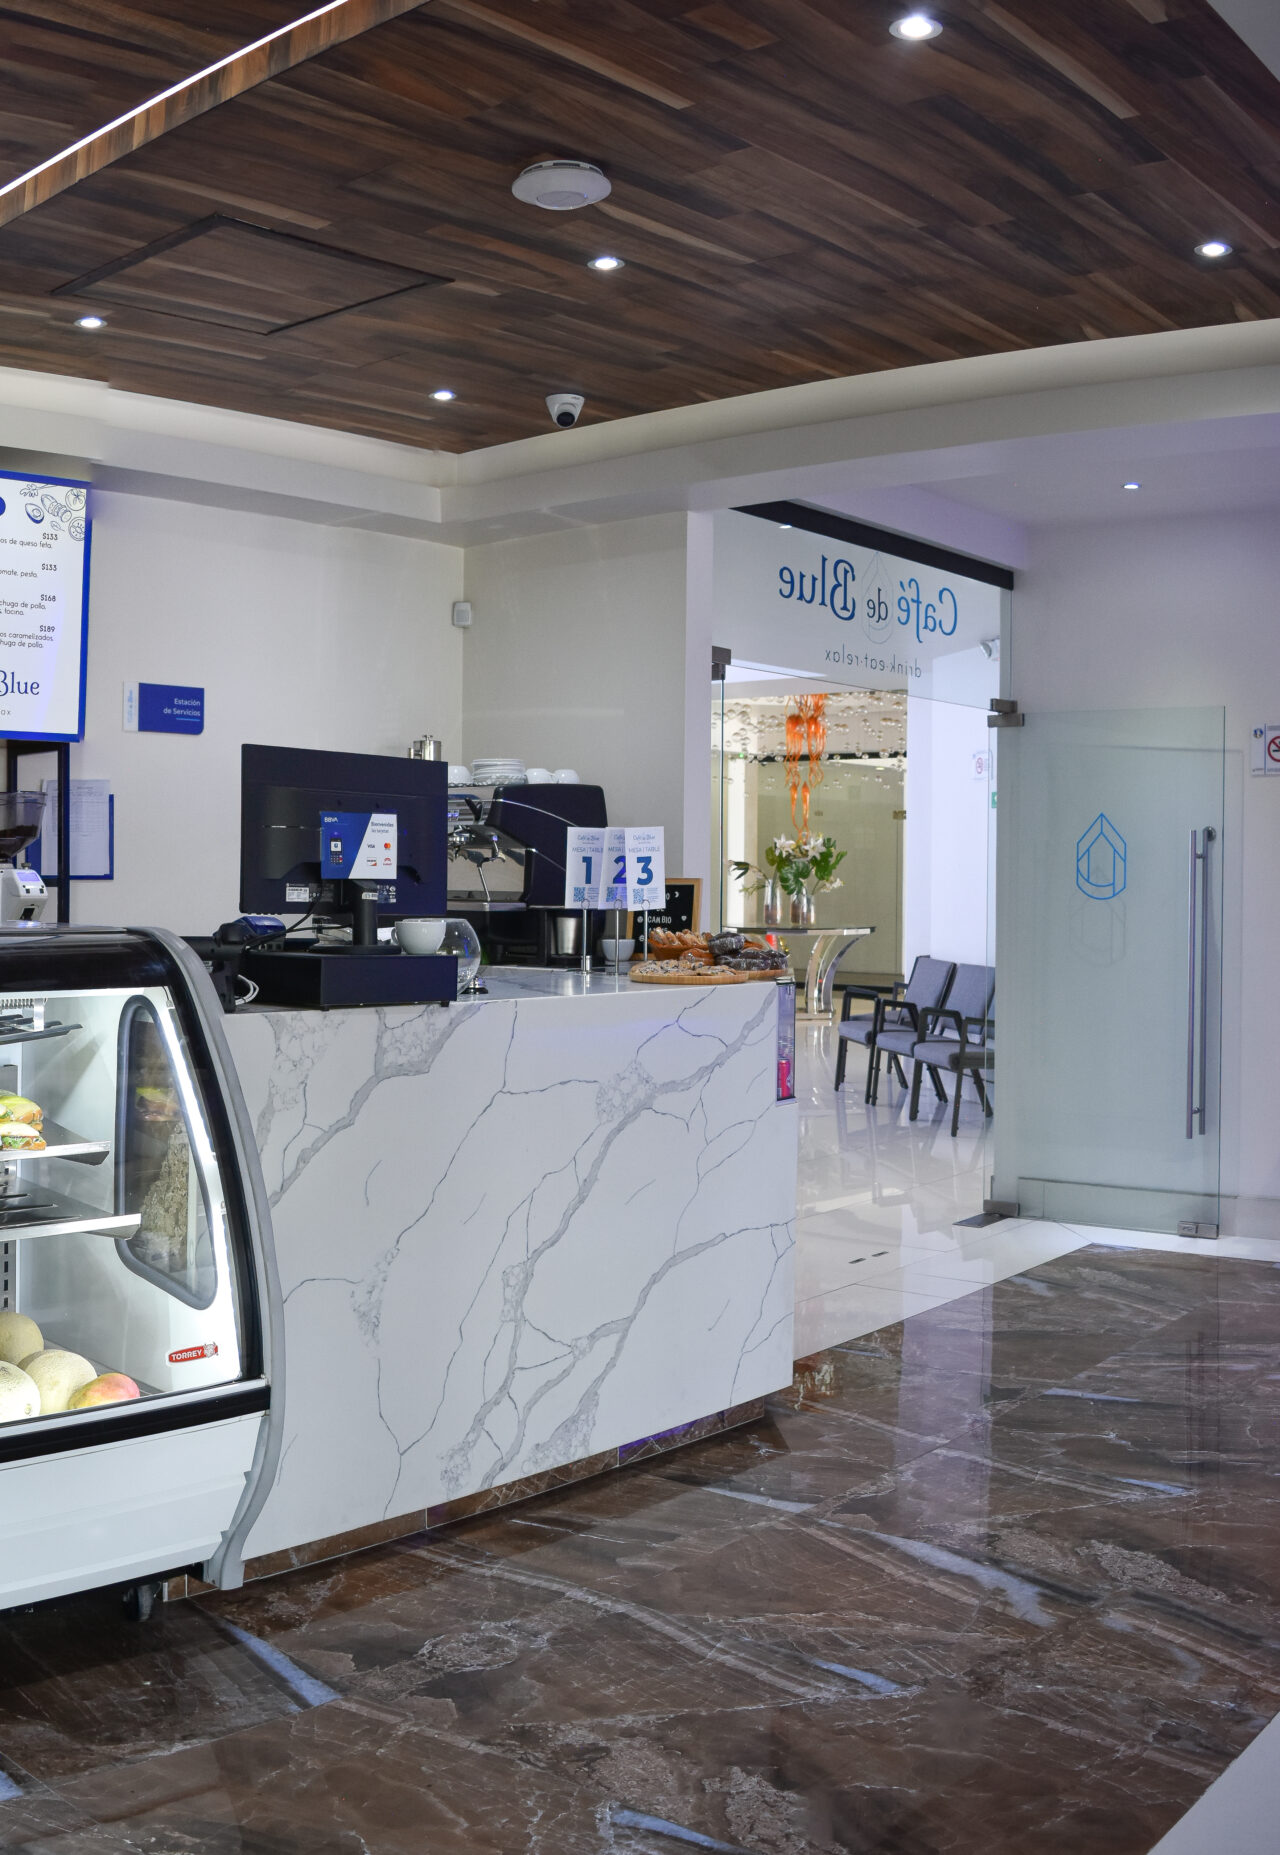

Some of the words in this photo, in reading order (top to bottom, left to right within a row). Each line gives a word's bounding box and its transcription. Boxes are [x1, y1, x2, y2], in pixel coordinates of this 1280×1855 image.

[40, 594, 56, 602] $168
[173, 708, 200, 716] Servicios
[582, 856, 592, 884] 1
[613, 856, 626, 884] 2
[636, 856, 653, 885] 3
[171, 1349, 202, 1360] TORREY
